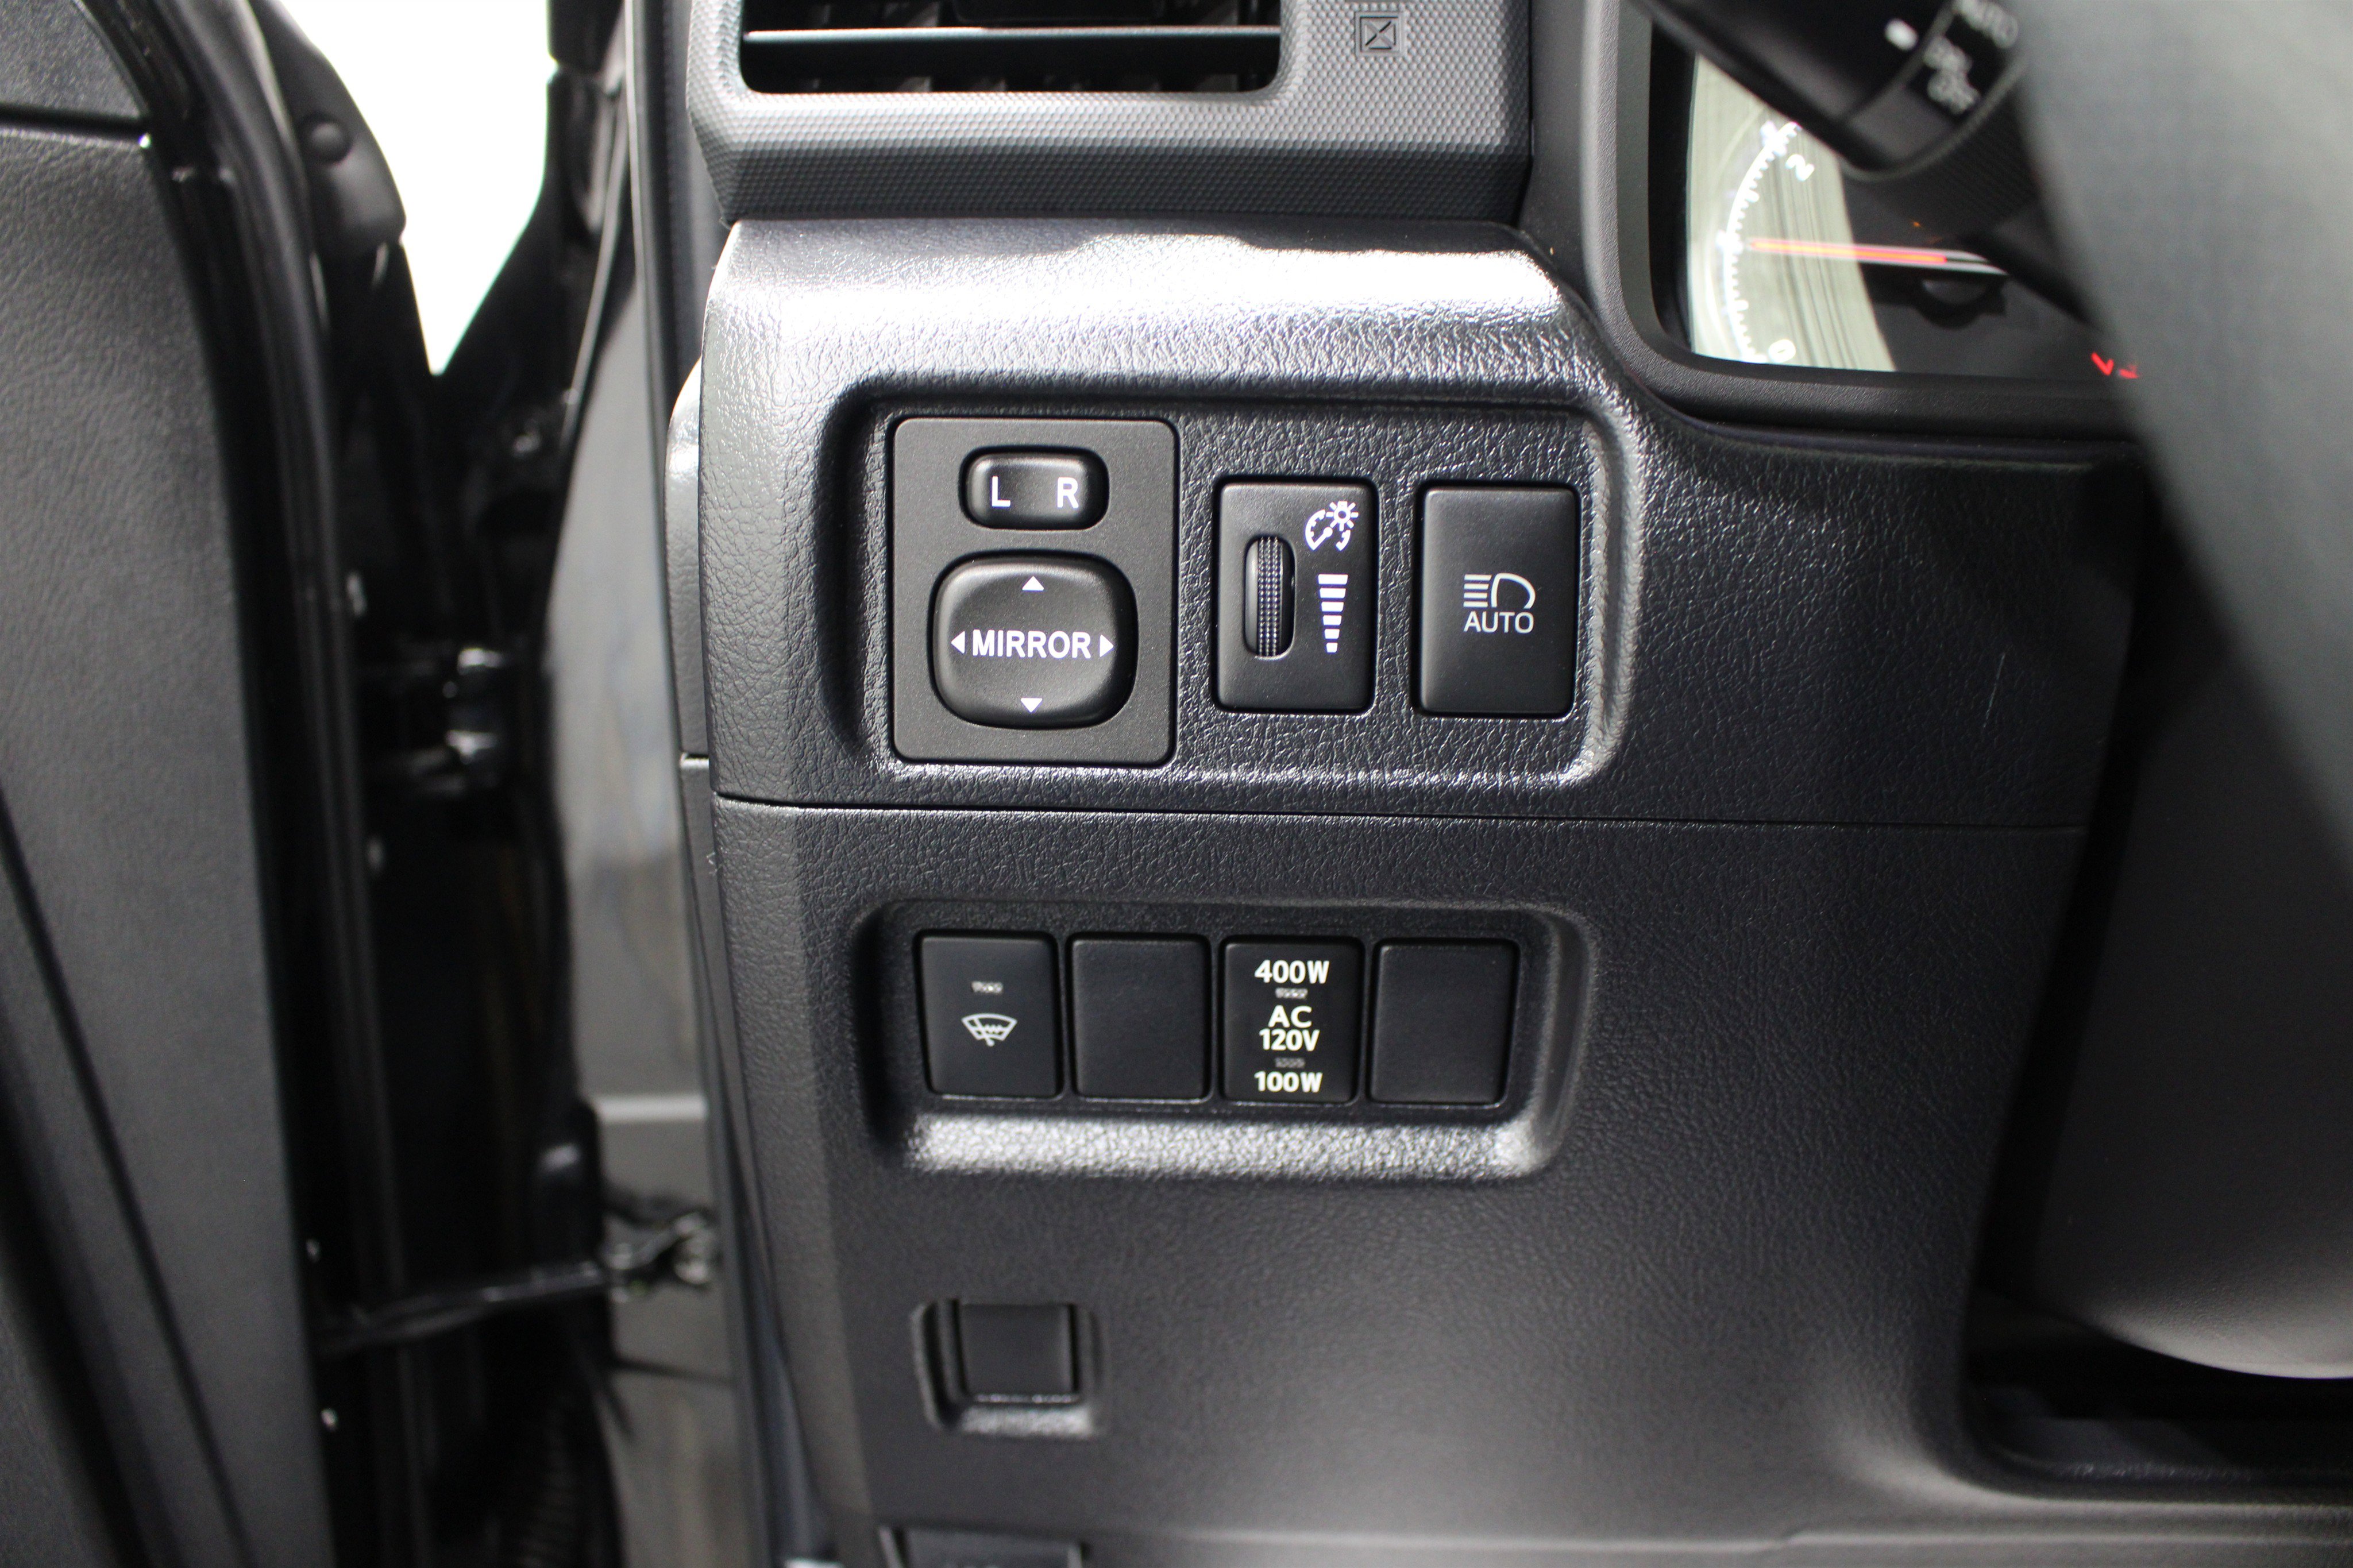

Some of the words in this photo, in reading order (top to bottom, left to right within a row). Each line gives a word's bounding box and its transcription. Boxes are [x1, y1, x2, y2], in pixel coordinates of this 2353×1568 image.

[1785, 153, 1815, 181] 2
[1768, 339, 1796, 363] 0
[992, 476, 1011, 507] L
[1056, 477, 1079, 509] R
[1463, 611, 1534, 634] AUTO
[973, 629, 1091, 659] MIRROR
[1254, 959, 1330, 984] 400W
[1268, 1005, 1312, 1028] AC
[1259, 1028, 1320, 1052] 120V
[1253, 1071, 1323, 1093] 100W
